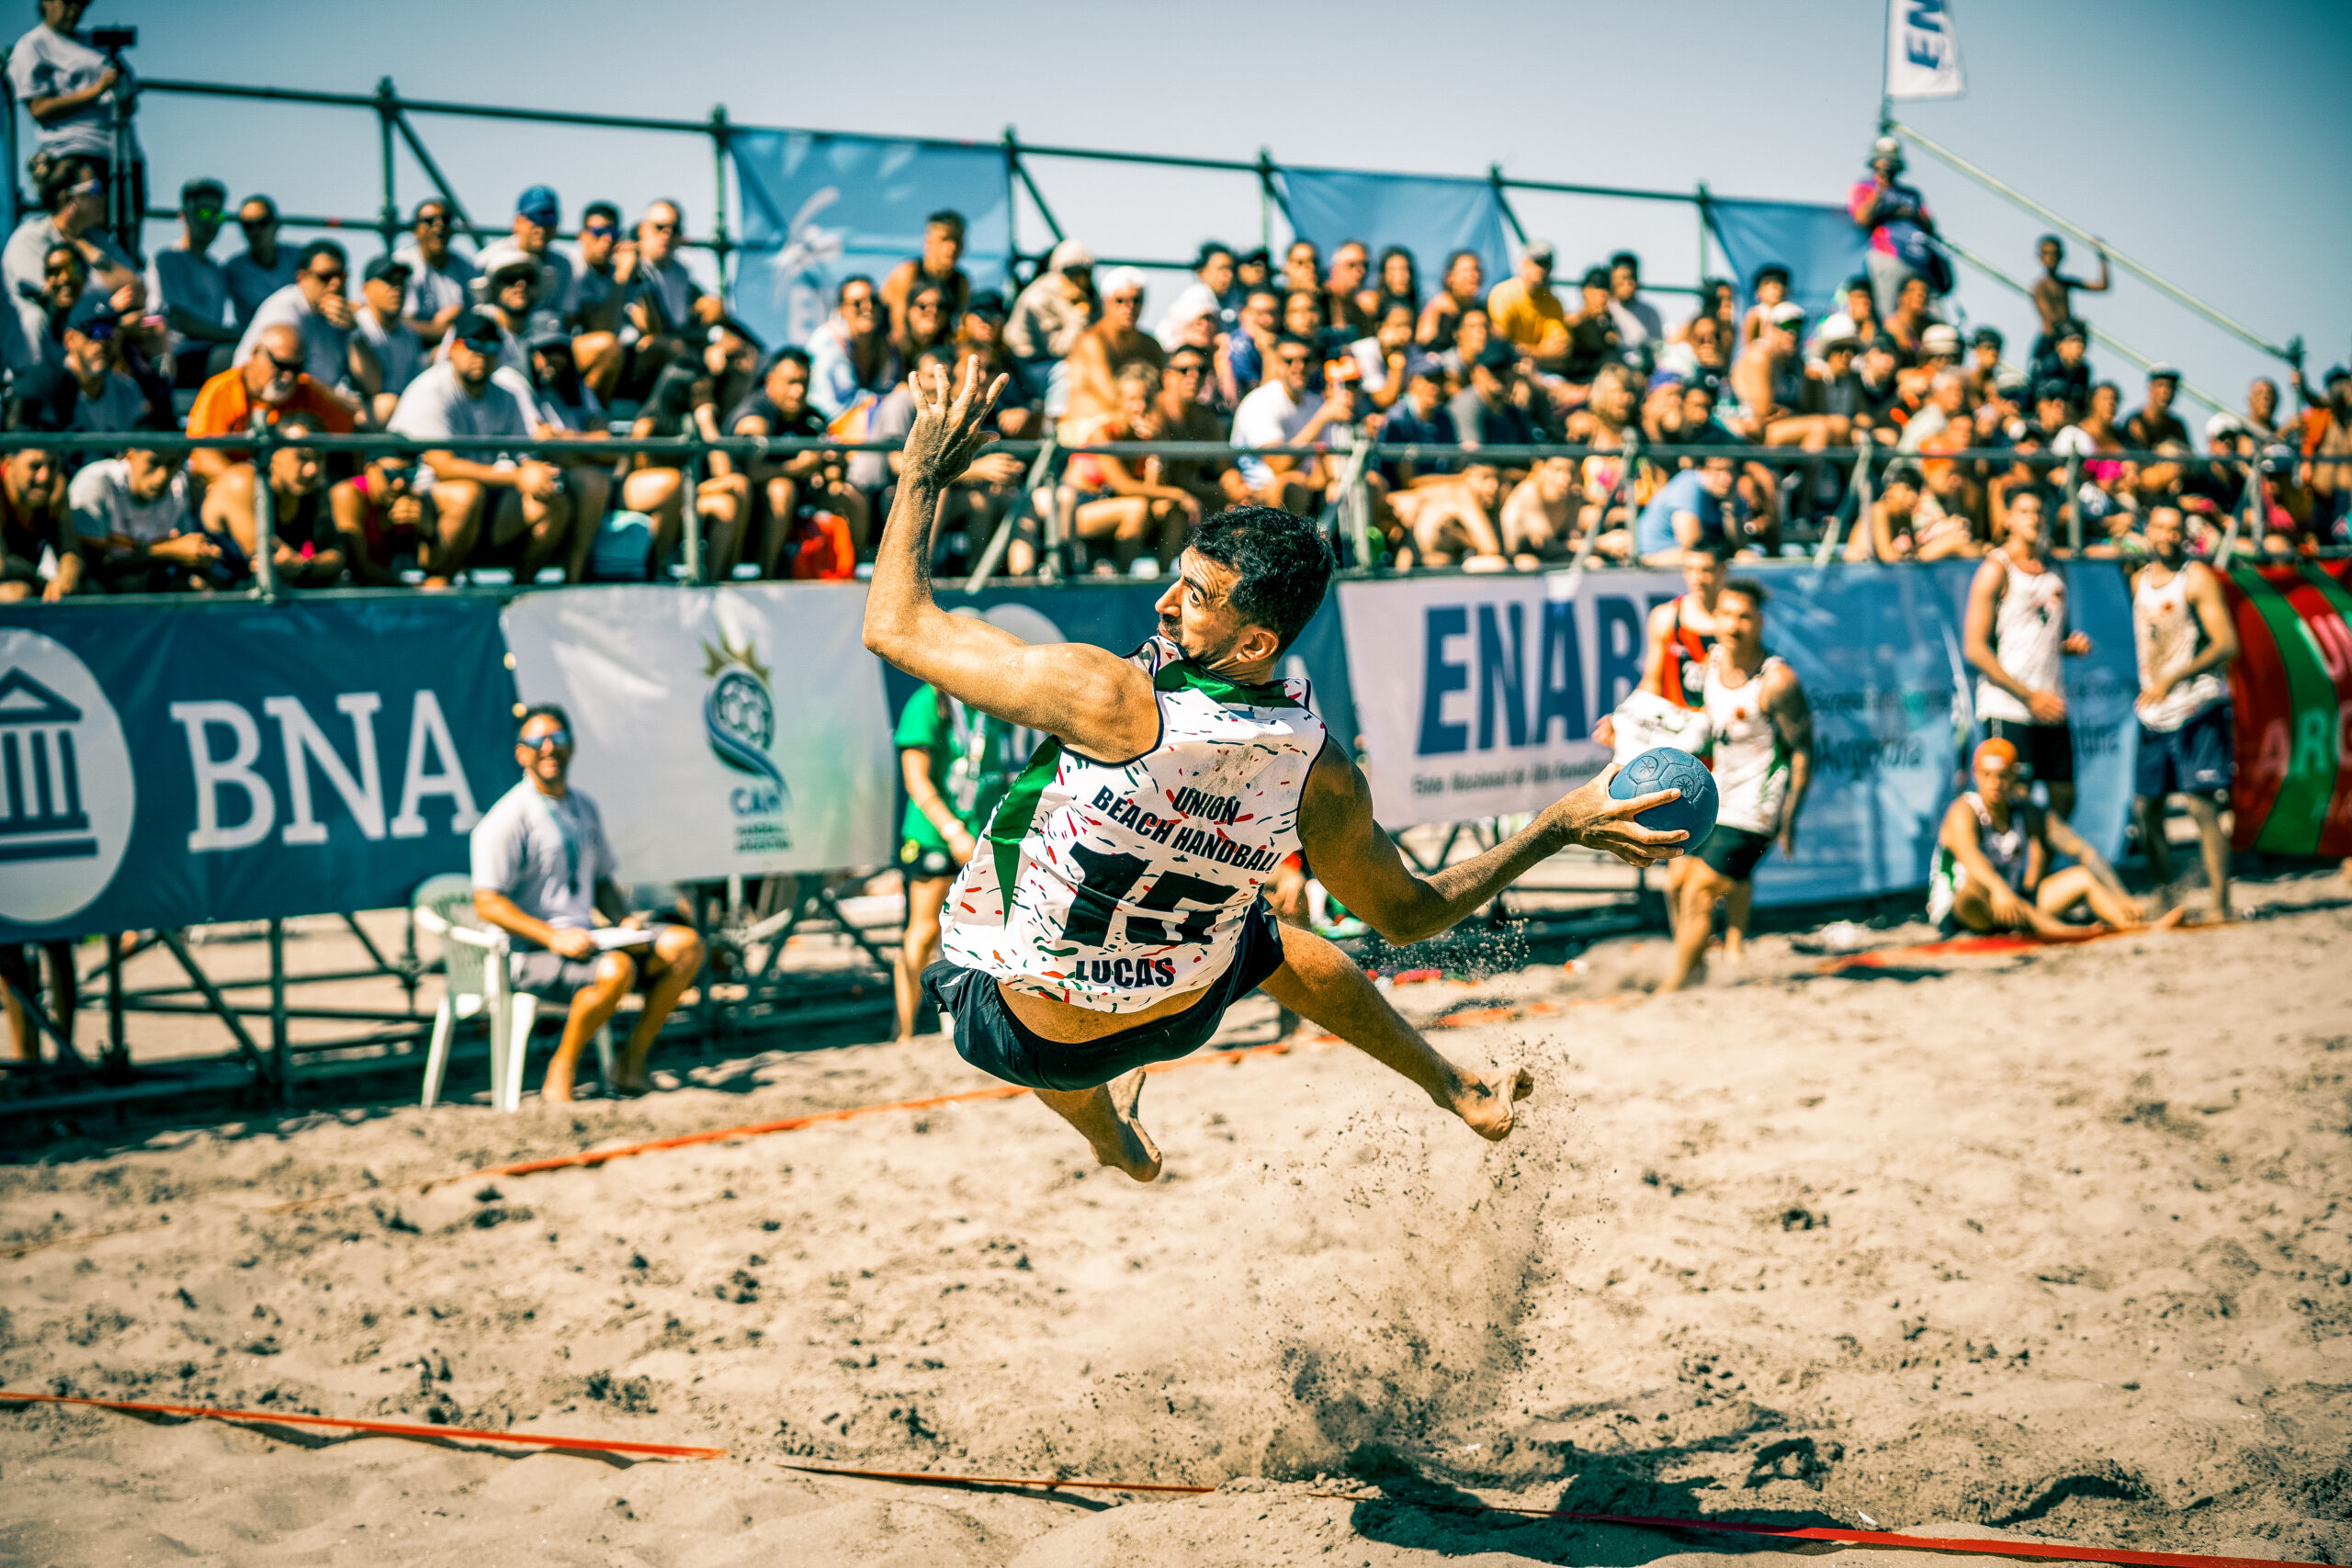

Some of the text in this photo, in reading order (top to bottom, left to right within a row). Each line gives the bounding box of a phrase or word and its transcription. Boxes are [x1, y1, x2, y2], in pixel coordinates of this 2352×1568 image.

[1417, 592, 1685, 756] ENAR
[170, 689, 483, 852] BNA
[1171, 786, 1241, 826] UNION
[1091, 784, 1282, 872] BEACH HANDBALL
[1075, 956, 1174, 987] LUCAS
